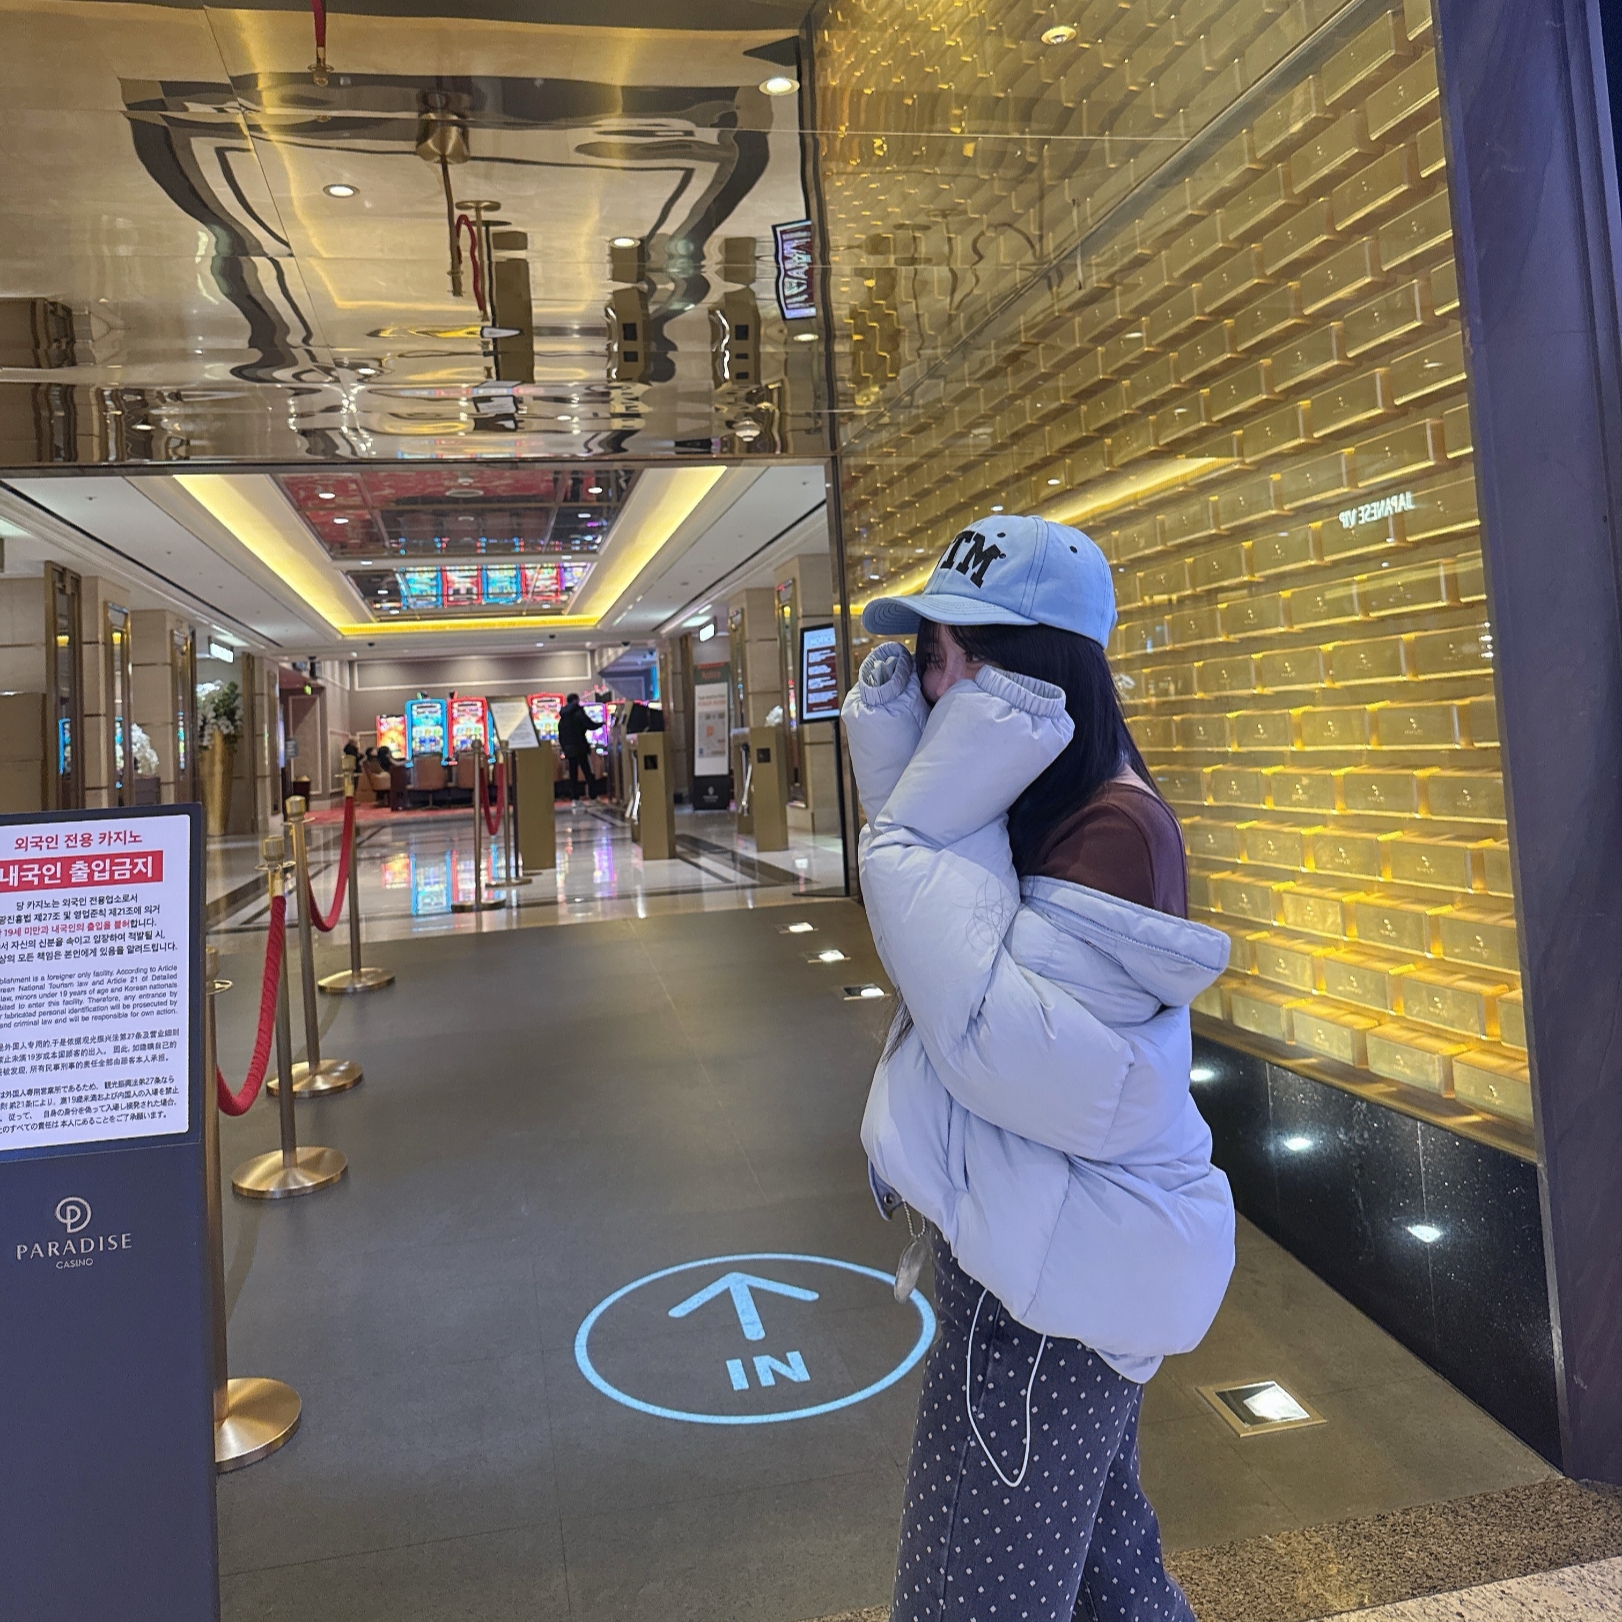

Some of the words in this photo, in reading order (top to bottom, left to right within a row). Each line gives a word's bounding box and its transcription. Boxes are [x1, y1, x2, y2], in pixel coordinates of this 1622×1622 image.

[939, 530, 1001, 589] TM
[14, 834, 58, 852] 외국인
[64, 833, 93, 849] 전용
[98, 830, 142, 846] 카지노
[0, 862, 61, 886] 내국인
[69, 856, 153, 882] 출입금지
[16, 901, 24, 911] 당
[27, 899, 60, 910] 카지노는
[62, 896, 87, 907] 외국인
[89, 893, 138, 906] 전용업소로서
[34, 912, 60, 922] 제27조
[63, 911, 71, 920] 및
[73, 908, 106, 920] 영업준칙
[108, 906, 142, 917] 제21조에
[144, 904, 160, 914] 의거
[4, 927, 22, 937] 19세
[24, 925, 49, 936] 미만과
[51, 922, 85, 934] 내국인의
[87, 921, 111, 932] 출입을
[0, 941, 8, 951] 서
[11, 939, 36, 950] 자신의
[39, 937, 63, 948] 신분을
[66, 935, 91, 946] 속이고
[93, 932, 126, 944] 입장하여
[128, 930, 153, 941] 적발될
[17, 952, 34, 962] 모든
[37, 951, 62, 961] 책임은
[64, 947, 97, 959] 본인에게
[100, 946, 124, 956] 있음을
[126, 941, 177, 954] 알려드립니다.
[18, 983, 45, 992] National
[48, 980, 74, 989] Tourism
[106, 977, 127, 985] Article
[141, 973, 148, 982] of
[151, 973, 178, 981] Detailed
[47, 973, 76, 981] foreigner
[77, 971, 91, 979] only
[116, 967, 148, 975] According
[38, 991, 58, 999] under
[69, 990, 87, 998] years
[96, 988, 109, 996] age
[149, 982, 178, 990] nationals
[87, 994, 120, 1003] Therefore,
[123, 994, 136, 1002] any
[169, 990, 178, 998] by
[4, 1010, 37, 1019] fabricated
[38, 1008, 66, 1018] personal
[68, 1005, 109, 1014] identification
[132, 999, 168, 1010] prosecuted
[169, 999, 178, 1007] by
[13, 1019, 40, 1028] criminal
[91, 1012, 128, 1021] responsible
[130, 1009, 139, 1018] for
[156, 1006, 178, 1016] action.
[16, 1232, 133, 1261] PARADISE
[55, 1257, 94, 1270] CASINO
[725, 1350, 811, 1391] IN
